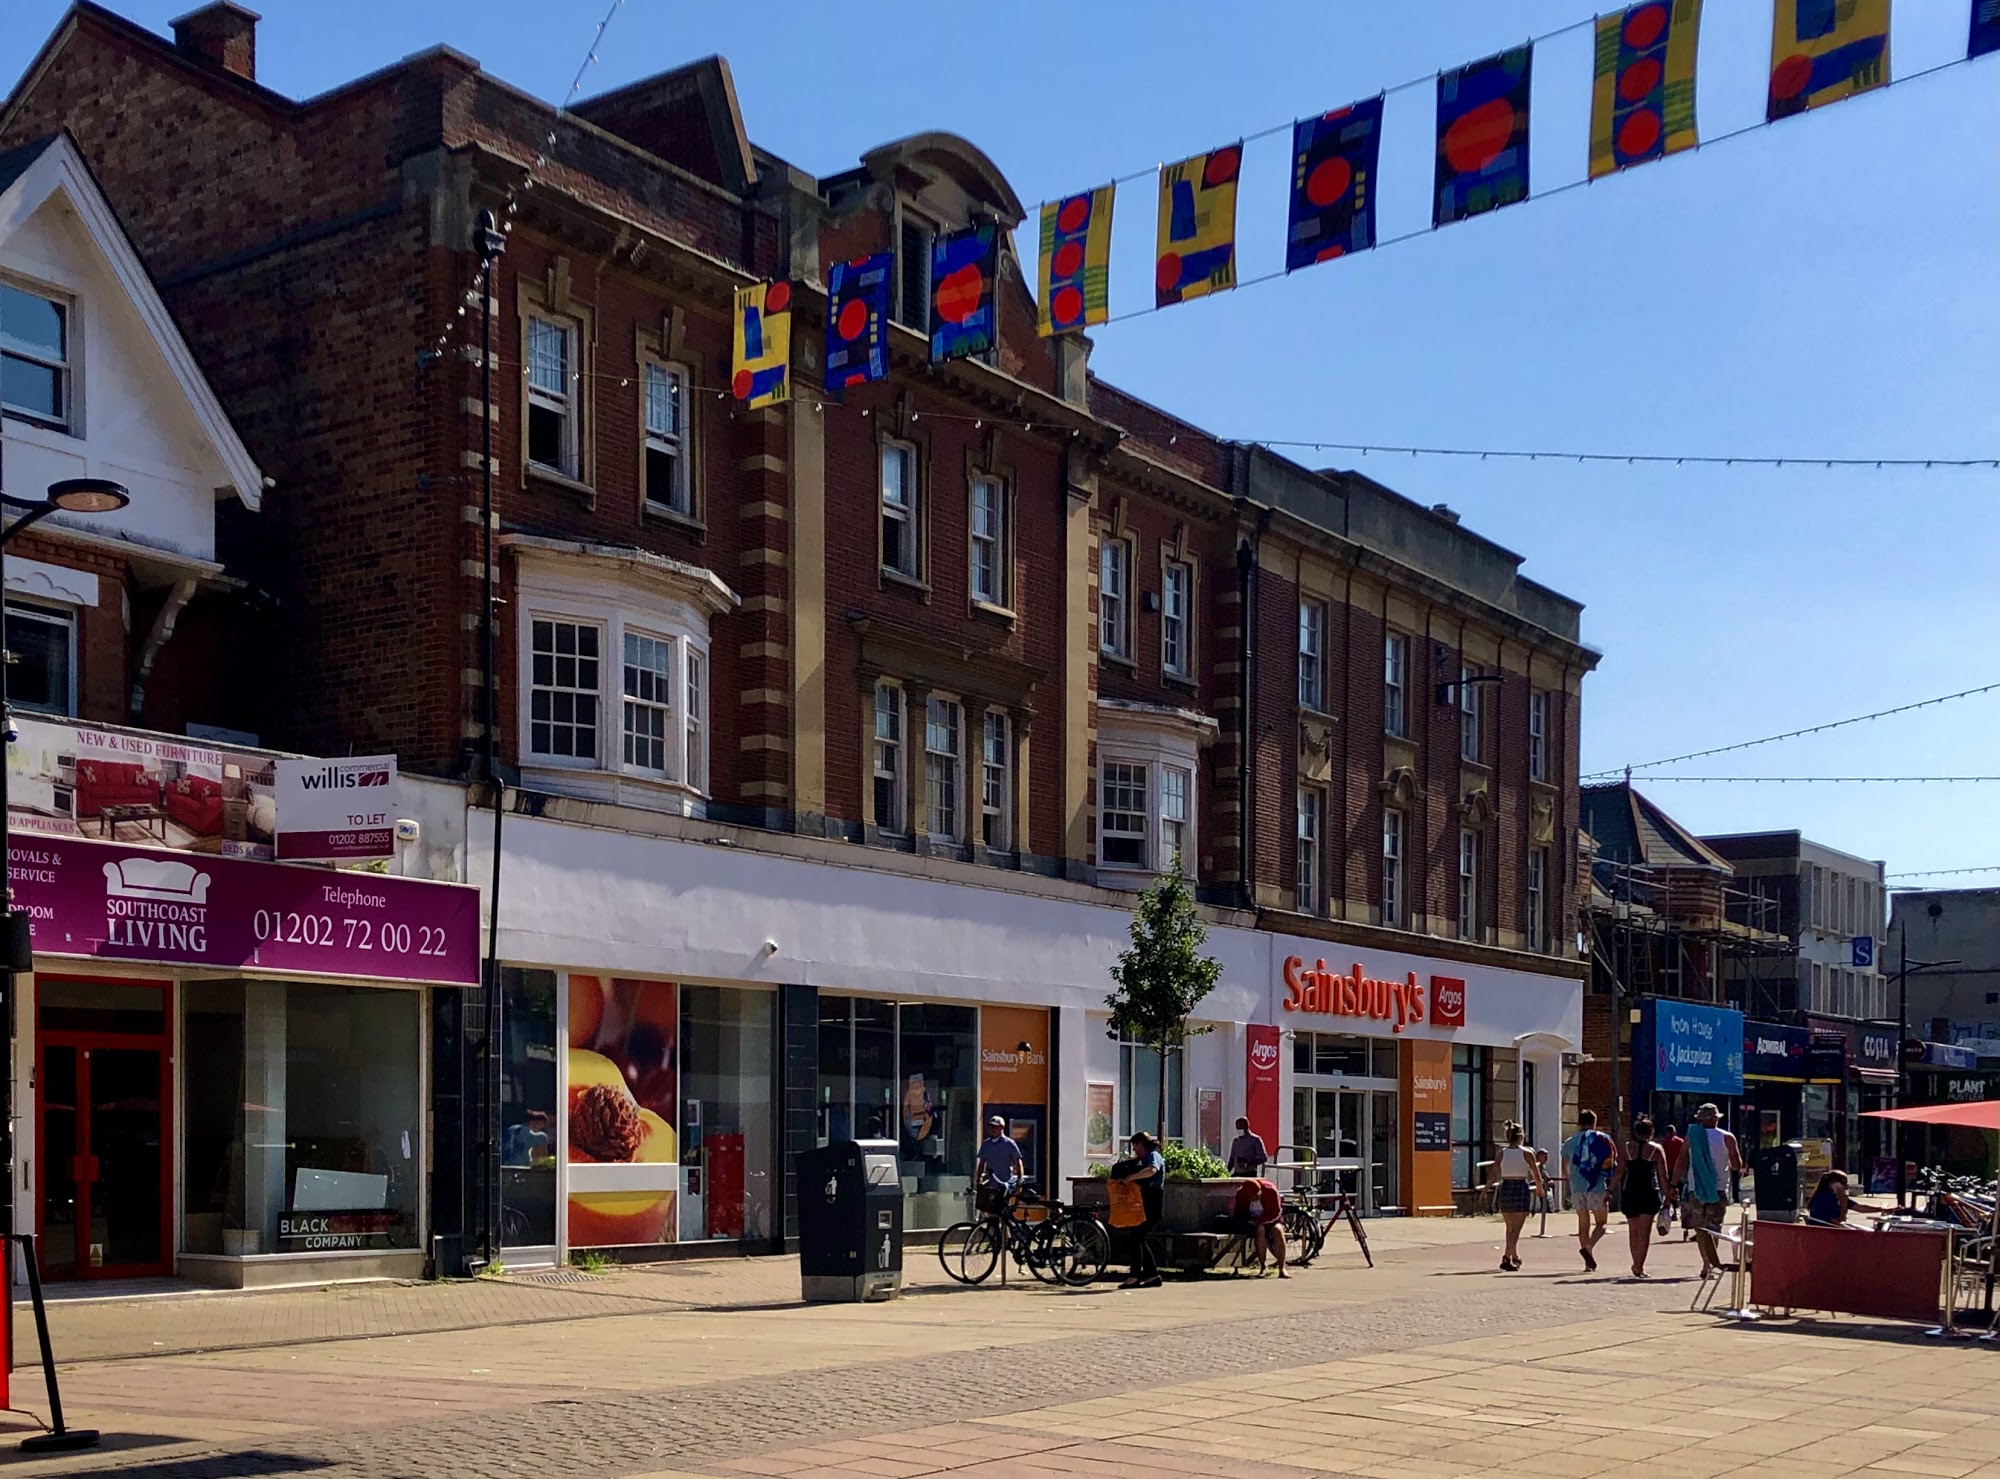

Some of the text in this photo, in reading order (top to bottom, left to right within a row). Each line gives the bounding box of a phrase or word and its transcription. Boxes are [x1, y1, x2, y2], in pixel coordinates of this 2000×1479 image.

[77, 731, 222, 766] NEW & USED FURNITURE
[301, 766, 356, 790] willis
[339, 761, 390, 773] commercial
[18, 818, 75, 834] APPLIANCES
[347, 813, 386, 826] TO LET
[222, 842, 244, 855] BEDS
[328, 832, 390, 845] 01202 887555
[52, 853, 62, 866] &
[322, 885, 386, 909] Telephone
[106, 898, 207, 923] SOUTHCOAST
[106, 918, 207, 952] LIVING
[253, 909, 447, 957] 01202 72 00 22
[1282, 954, 1425, 1034] Sainsbury's
[1438, 985, 1462, 1010] Argos
[982, 1048, 1045, 1067] Sainsburys Bank
[1251, 1039, 1278, 1062] Argos
[1756, 1036, 1788, 1058] ADMIRAL
[1864, 1035, 1889, 1060] COSTA
[1949, 1079, 1986, 1095] PLANT
[280, 1218, 329, 1234] BLACK
[305, 1235, 362, 1248] COMPANY
